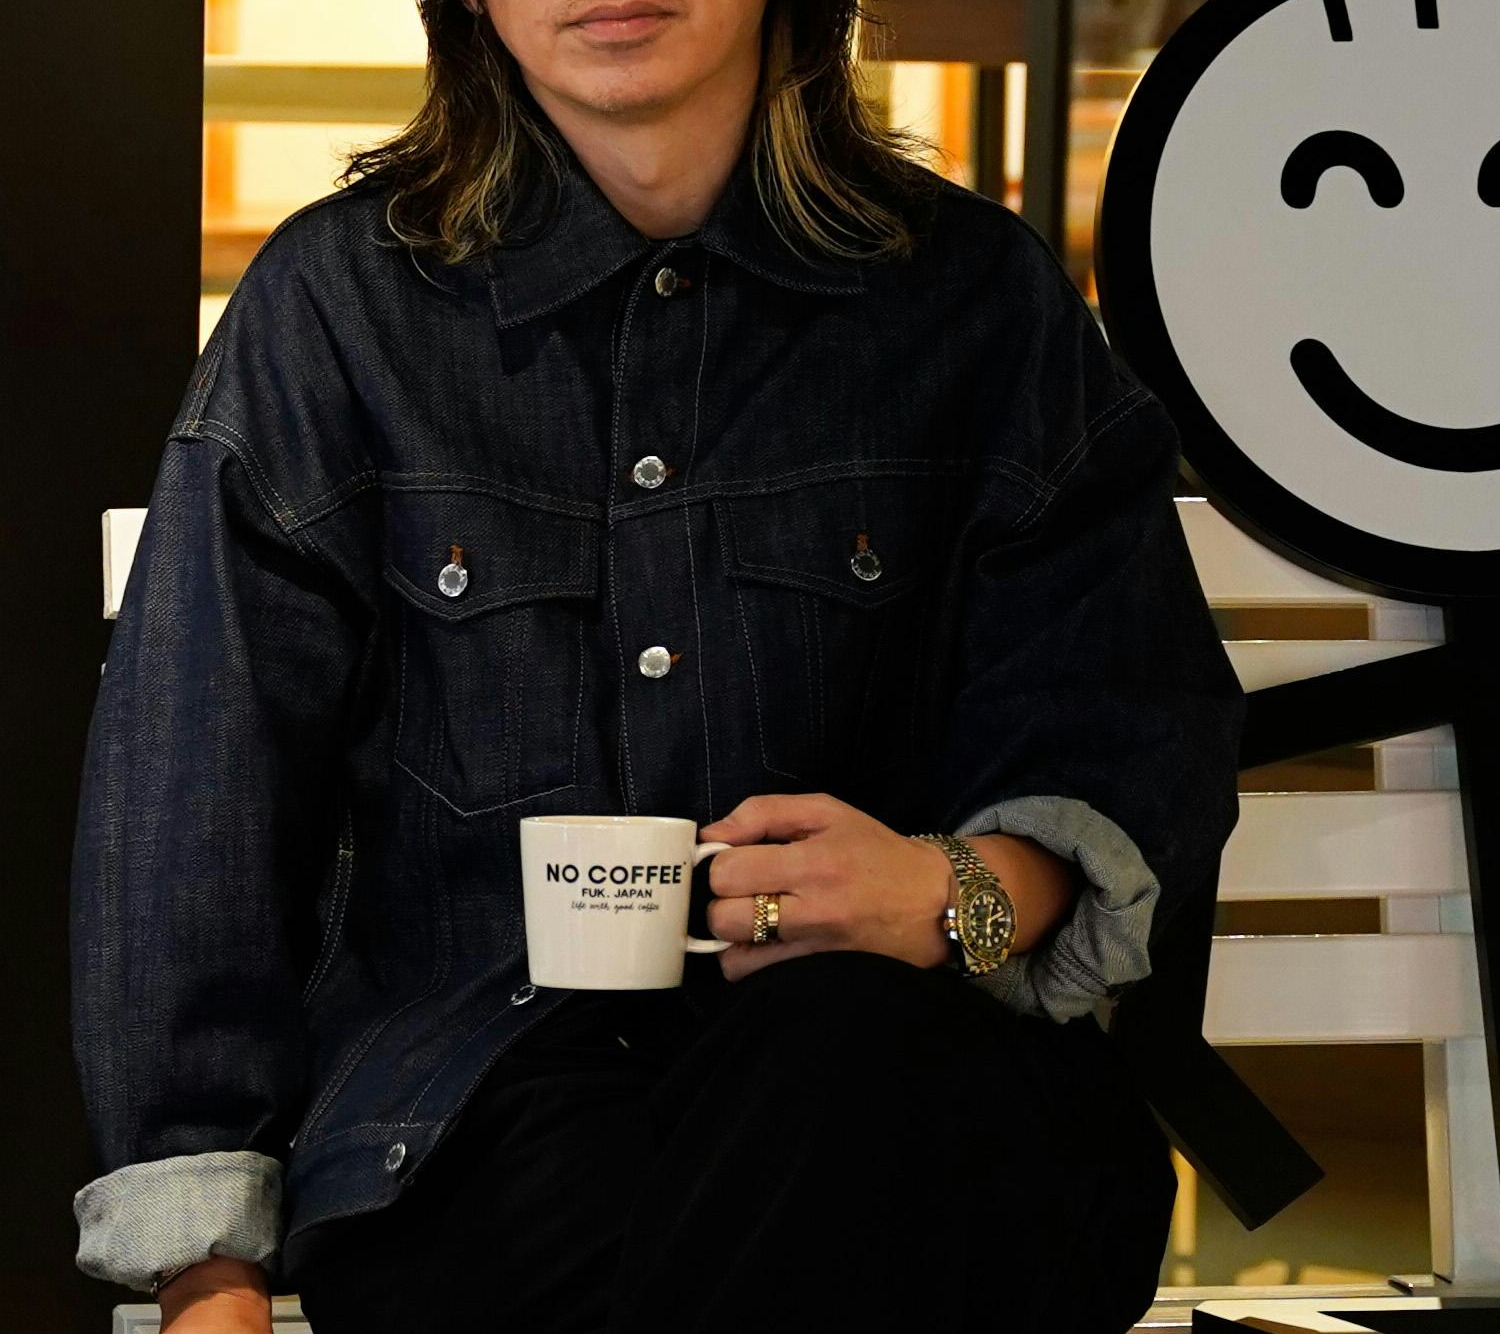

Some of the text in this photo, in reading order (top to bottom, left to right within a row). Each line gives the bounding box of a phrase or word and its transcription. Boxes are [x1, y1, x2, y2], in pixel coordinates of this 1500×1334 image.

[546, 863, 683, 885] NO COFFEE
[581, 888, 653, 898] FUK. JAPAN
